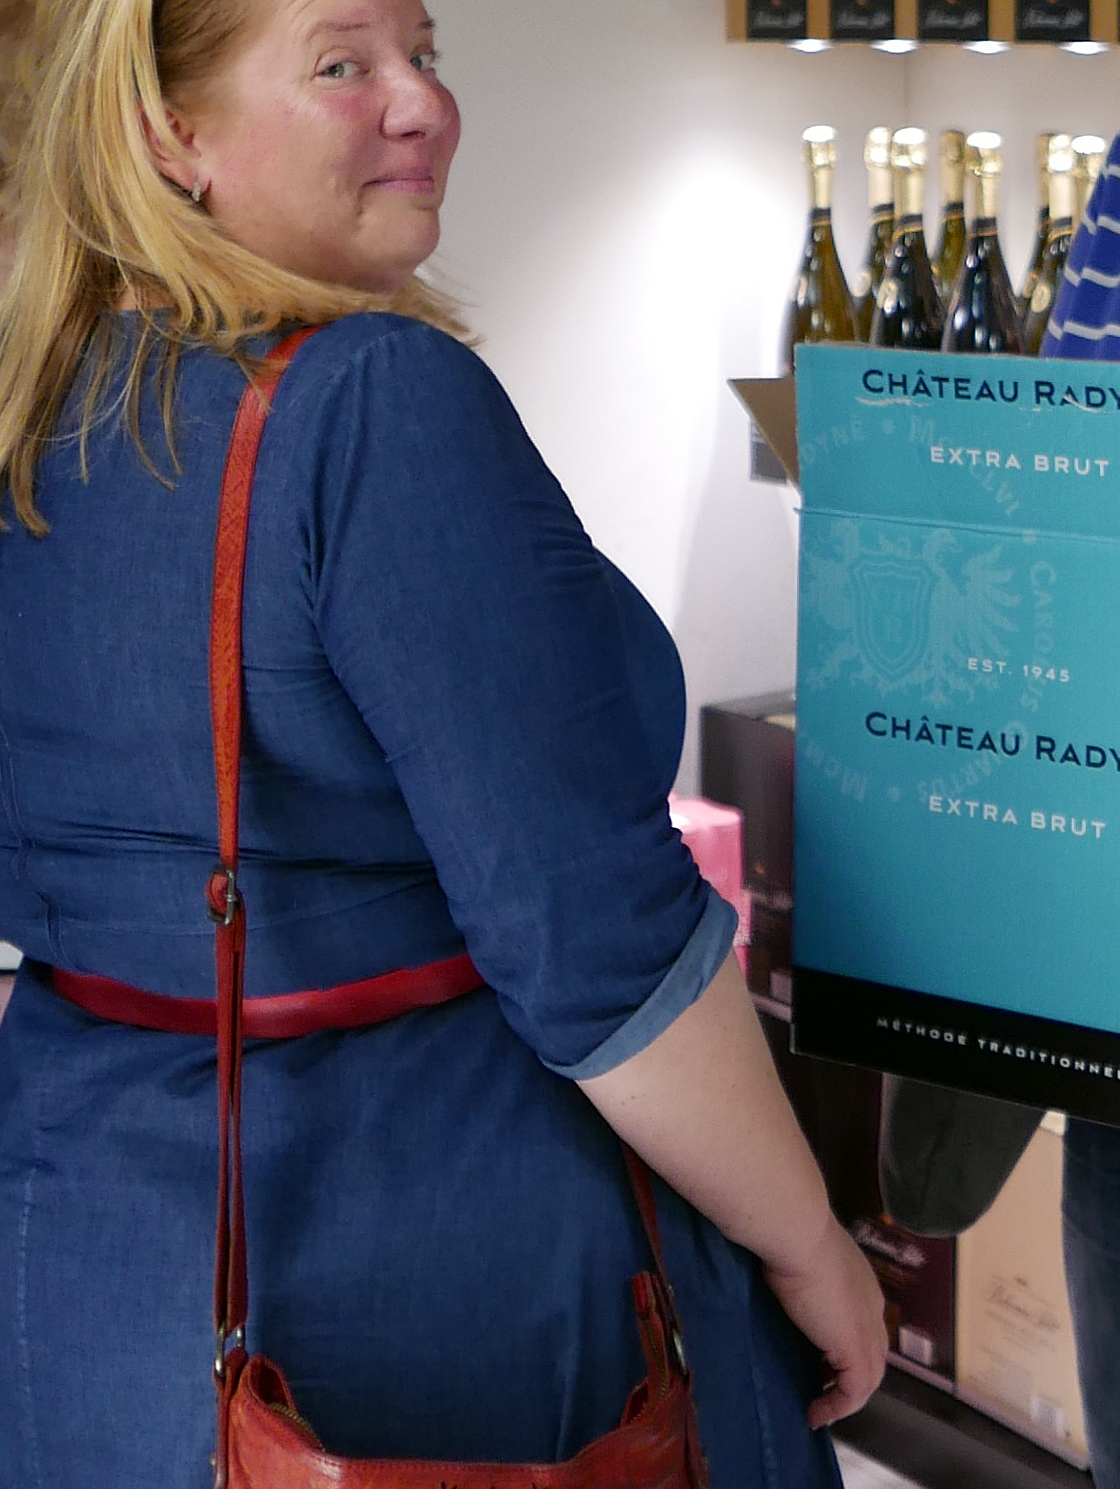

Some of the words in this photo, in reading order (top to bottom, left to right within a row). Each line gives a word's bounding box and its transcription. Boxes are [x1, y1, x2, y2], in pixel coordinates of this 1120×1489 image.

[862, 368, 1019, 403] CHÂTEAU
[930, 446, 1021, 470] EXTRA
[1034, 454, 1110, 477] BRUT
[967, 657, 1013, 675] EST.
[1022, 663, 1071, 683] 1945
[865, 711, 1020, 756] CHÂTEAU
[928, 795, 1018, 824] EXTRA
[1031, 811, 1106, 838] BRUT
[876, 1016, 967, 1046] MÉTHODE
